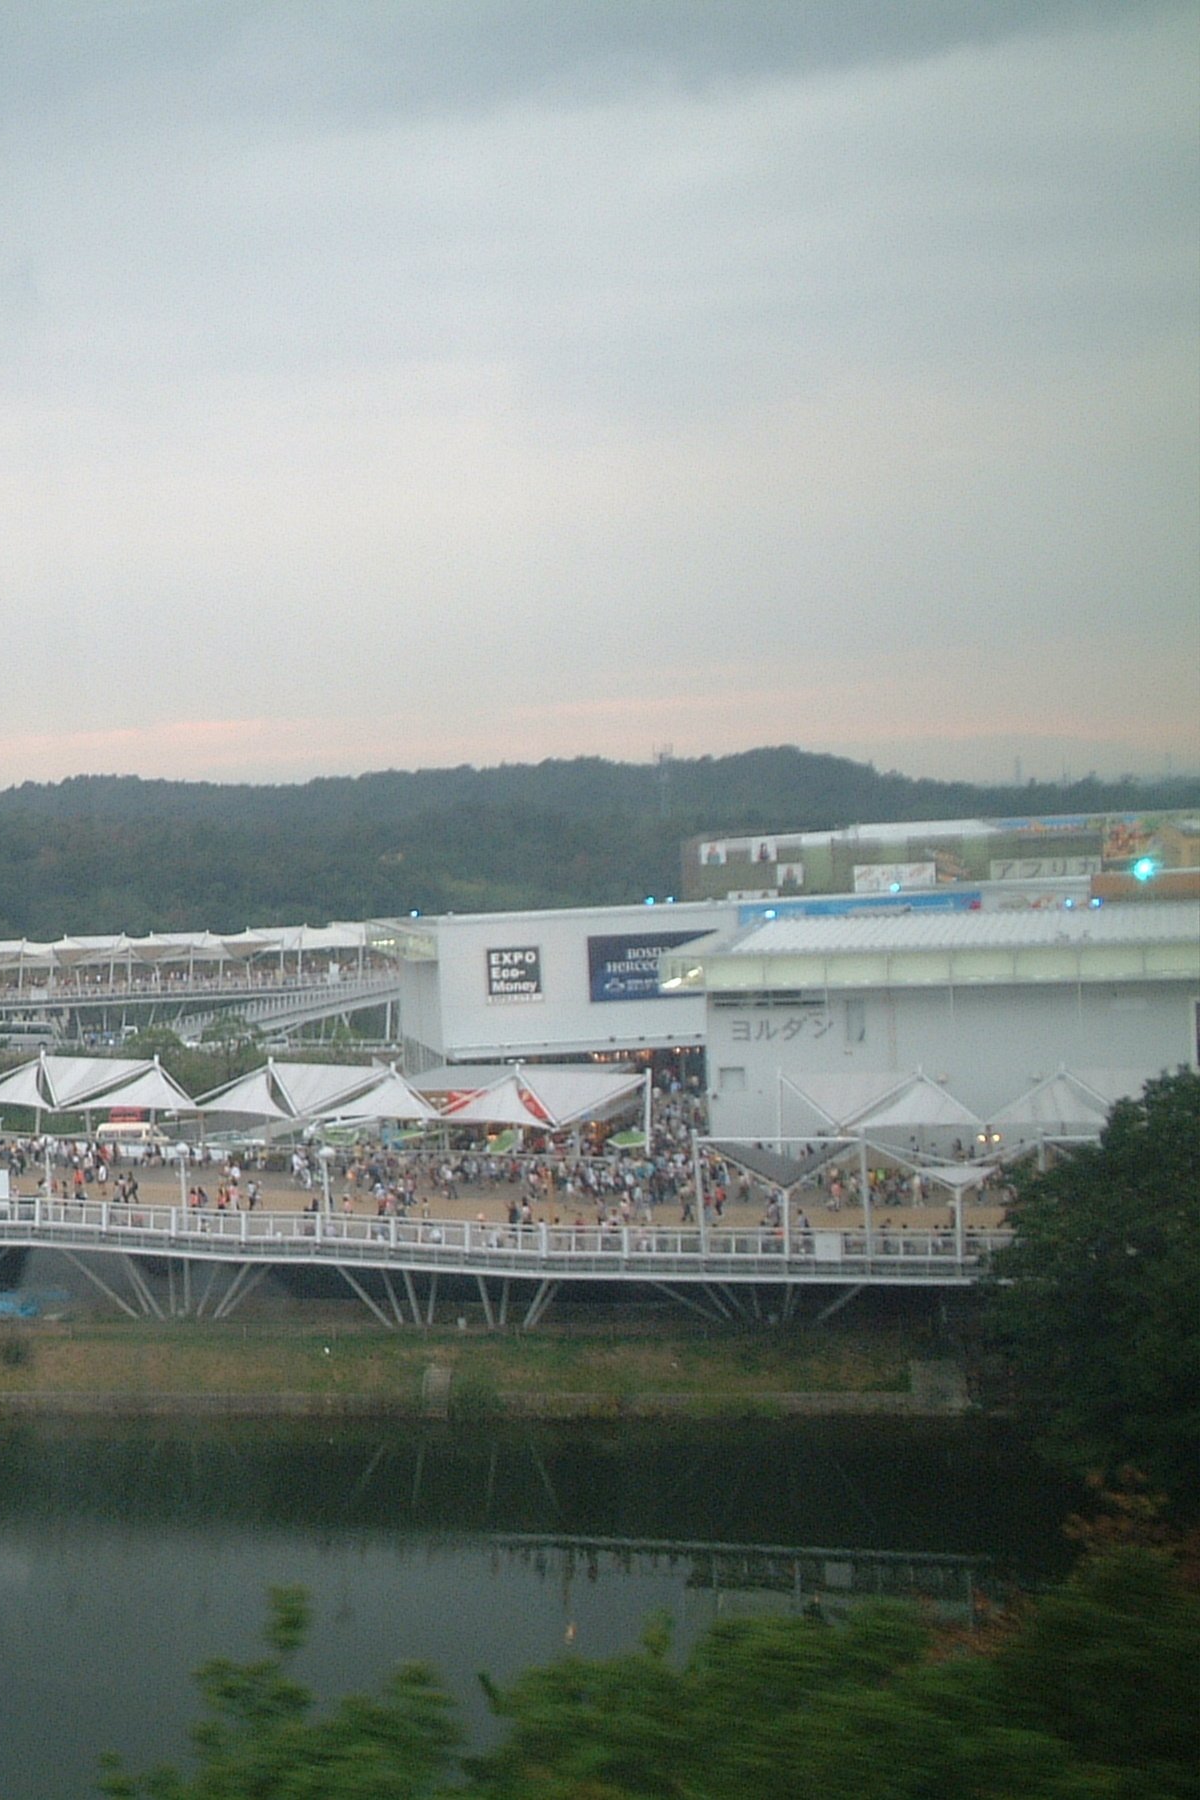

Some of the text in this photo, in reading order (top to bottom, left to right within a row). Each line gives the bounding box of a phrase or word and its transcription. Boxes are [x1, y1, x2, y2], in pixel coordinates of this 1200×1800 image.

[995, 856, 1097, 880] アフリカ
[490, 951, 536, 965] EXPO
[491, 967, 526, 979] Eco-
[492, 980, 537, 993] Money
[732, 1016, 834, 1041] ヨルダン
